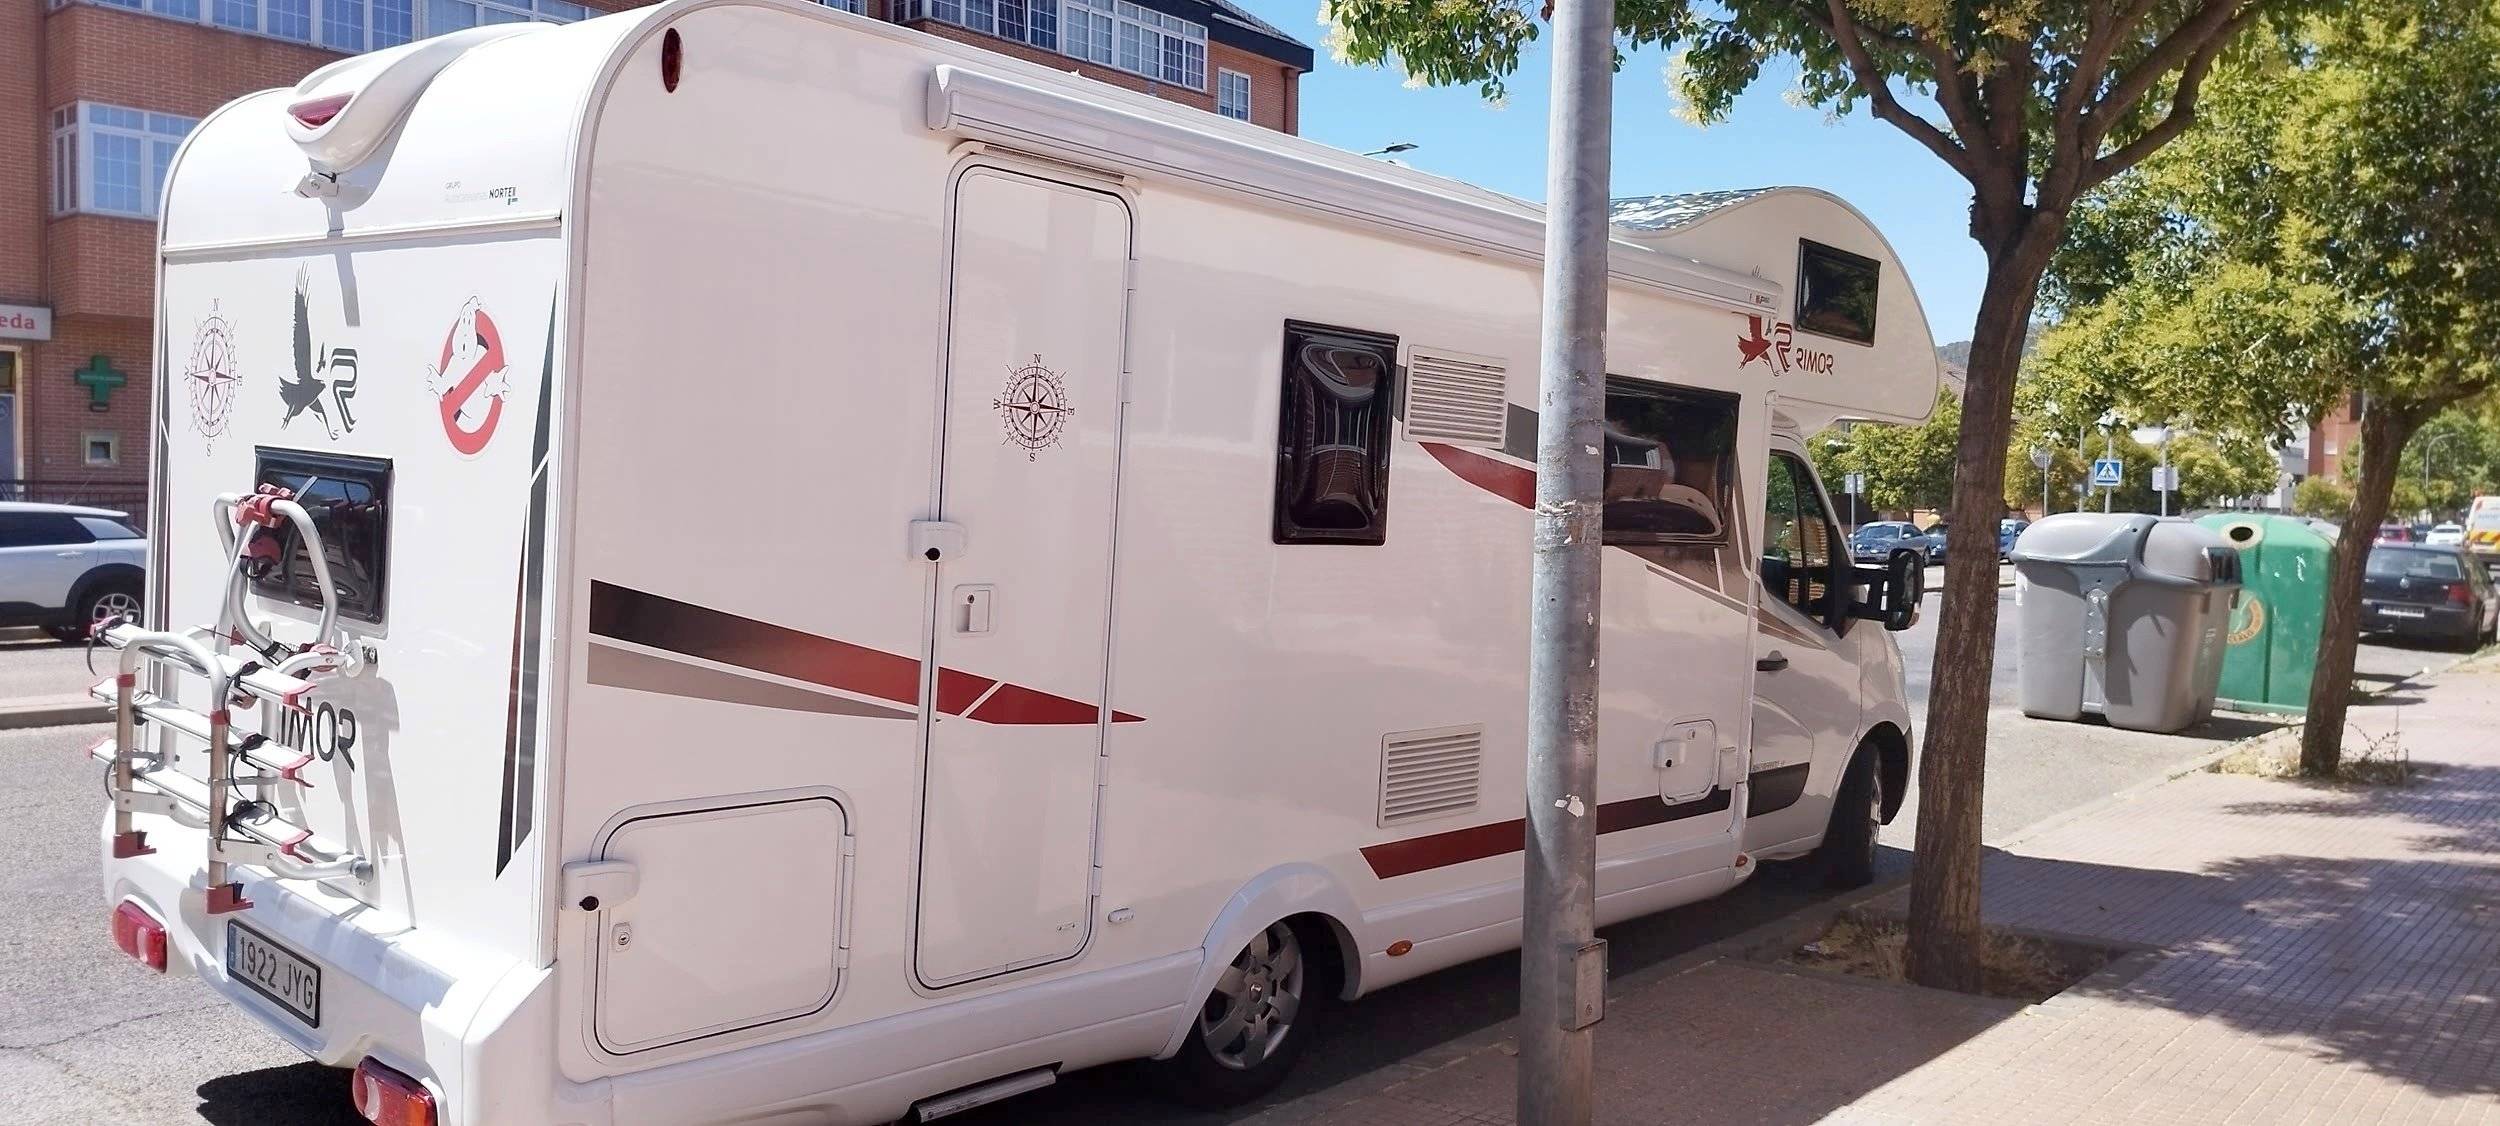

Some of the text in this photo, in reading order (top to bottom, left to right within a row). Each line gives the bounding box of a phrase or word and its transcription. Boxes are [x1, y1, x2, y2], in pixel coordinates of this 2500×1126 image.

[1034, 353, 1042, 364] N
[1796, 347, 1834, 376] RIMOR
[993, 398, 1002, 410] W
[1067, 407, 1075, 416] E
[1029, 452, 1036, 462] S
[276, 697, 356, 773] IMOR
[240, 936, 313, 1010] 1922 JYG
